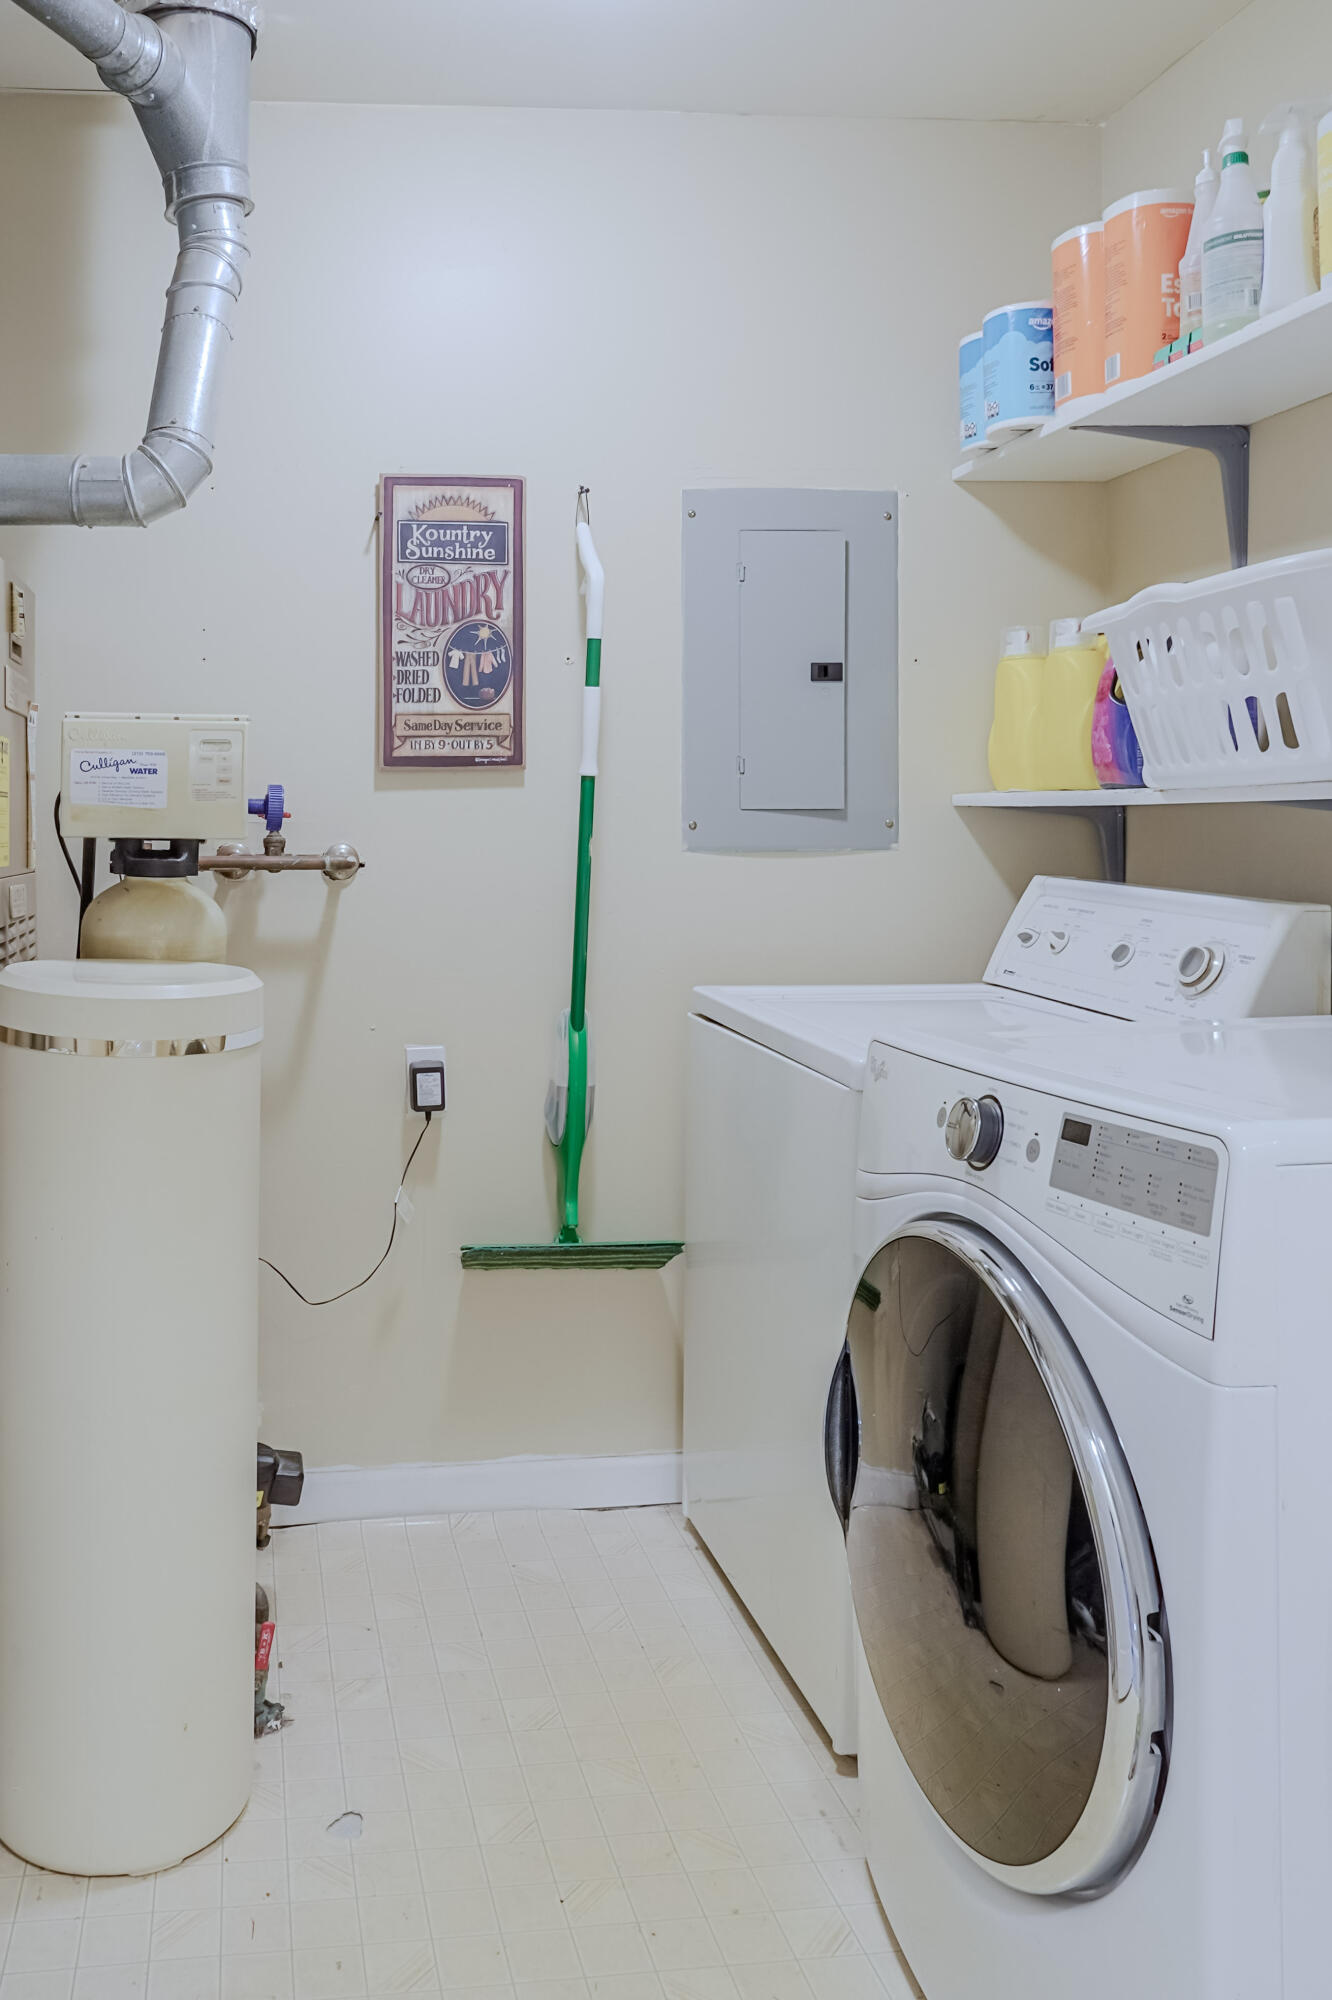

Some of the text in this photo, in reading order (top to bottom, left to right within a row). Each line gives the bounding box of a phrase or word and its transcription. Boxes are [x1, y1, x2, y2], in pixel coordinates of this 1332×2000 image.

[1028, 317, 1054, 330] amaz
[411, 524, 494, 548] Kountry
[406, 538, 496, 560] Sunshine
[419, 567, 436, 575] DRY
[412, 576, 446, 584] CLEANER
[396, 569, 510, 627] LAUNDRY
[396, 650, 440, 667] WASHED
[397, 669, 430, 685] DRIED
[396, 687, 442, 704] FOLDED
[455, 718, 503, 732] Service
[410, 739, 494, 750] IN BY 9 OUT BY 5
[79, 756, 137, 773] Culligan
[129, 767, 159, 776] WATER
